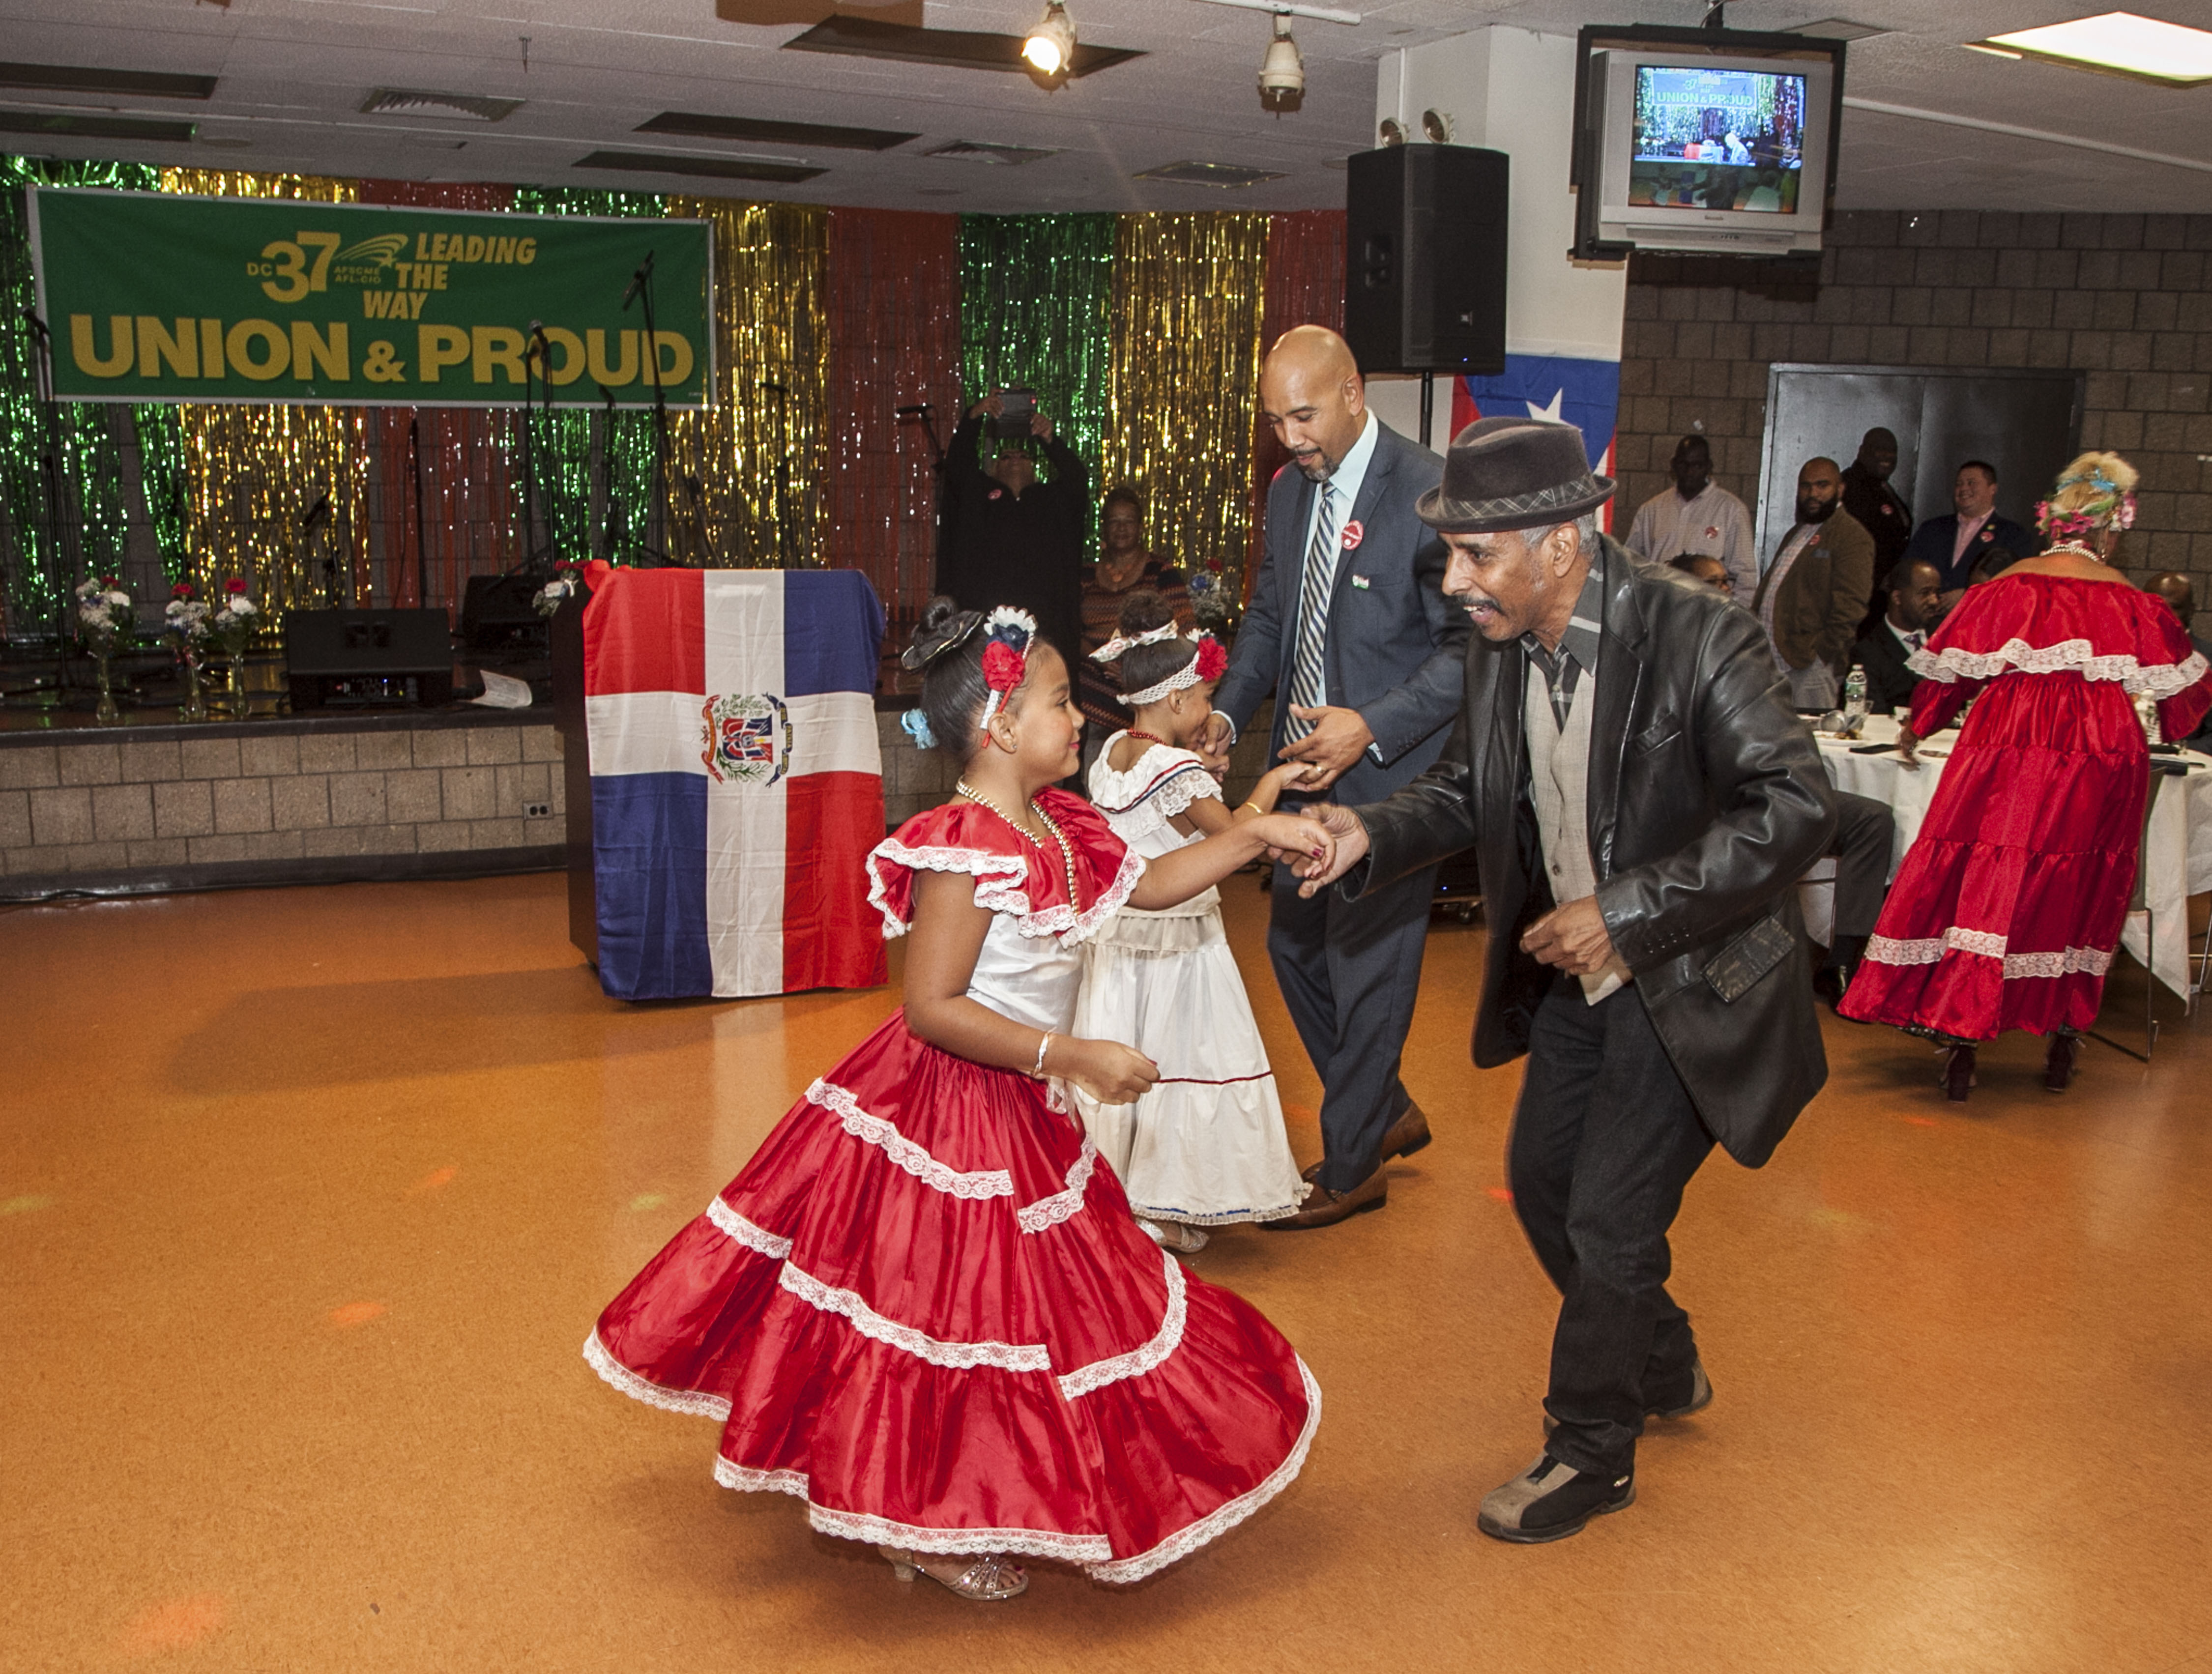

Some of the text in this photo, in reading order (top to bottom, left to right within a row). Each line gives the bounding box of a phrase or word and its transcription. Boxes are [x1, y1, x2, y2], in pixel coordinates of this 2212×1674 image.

[1657, 92, 1699, 103] UNION
[415, 232, 537, 265] LEADING
[246, 231, 341, 303] DC 37
[335, 274, 382, 284] AFL-CIO
[395, 262, 449, 290] THE
[363, 290, 428, 320] WAY
[70, 314, 694, 386] UNION & PROUD
